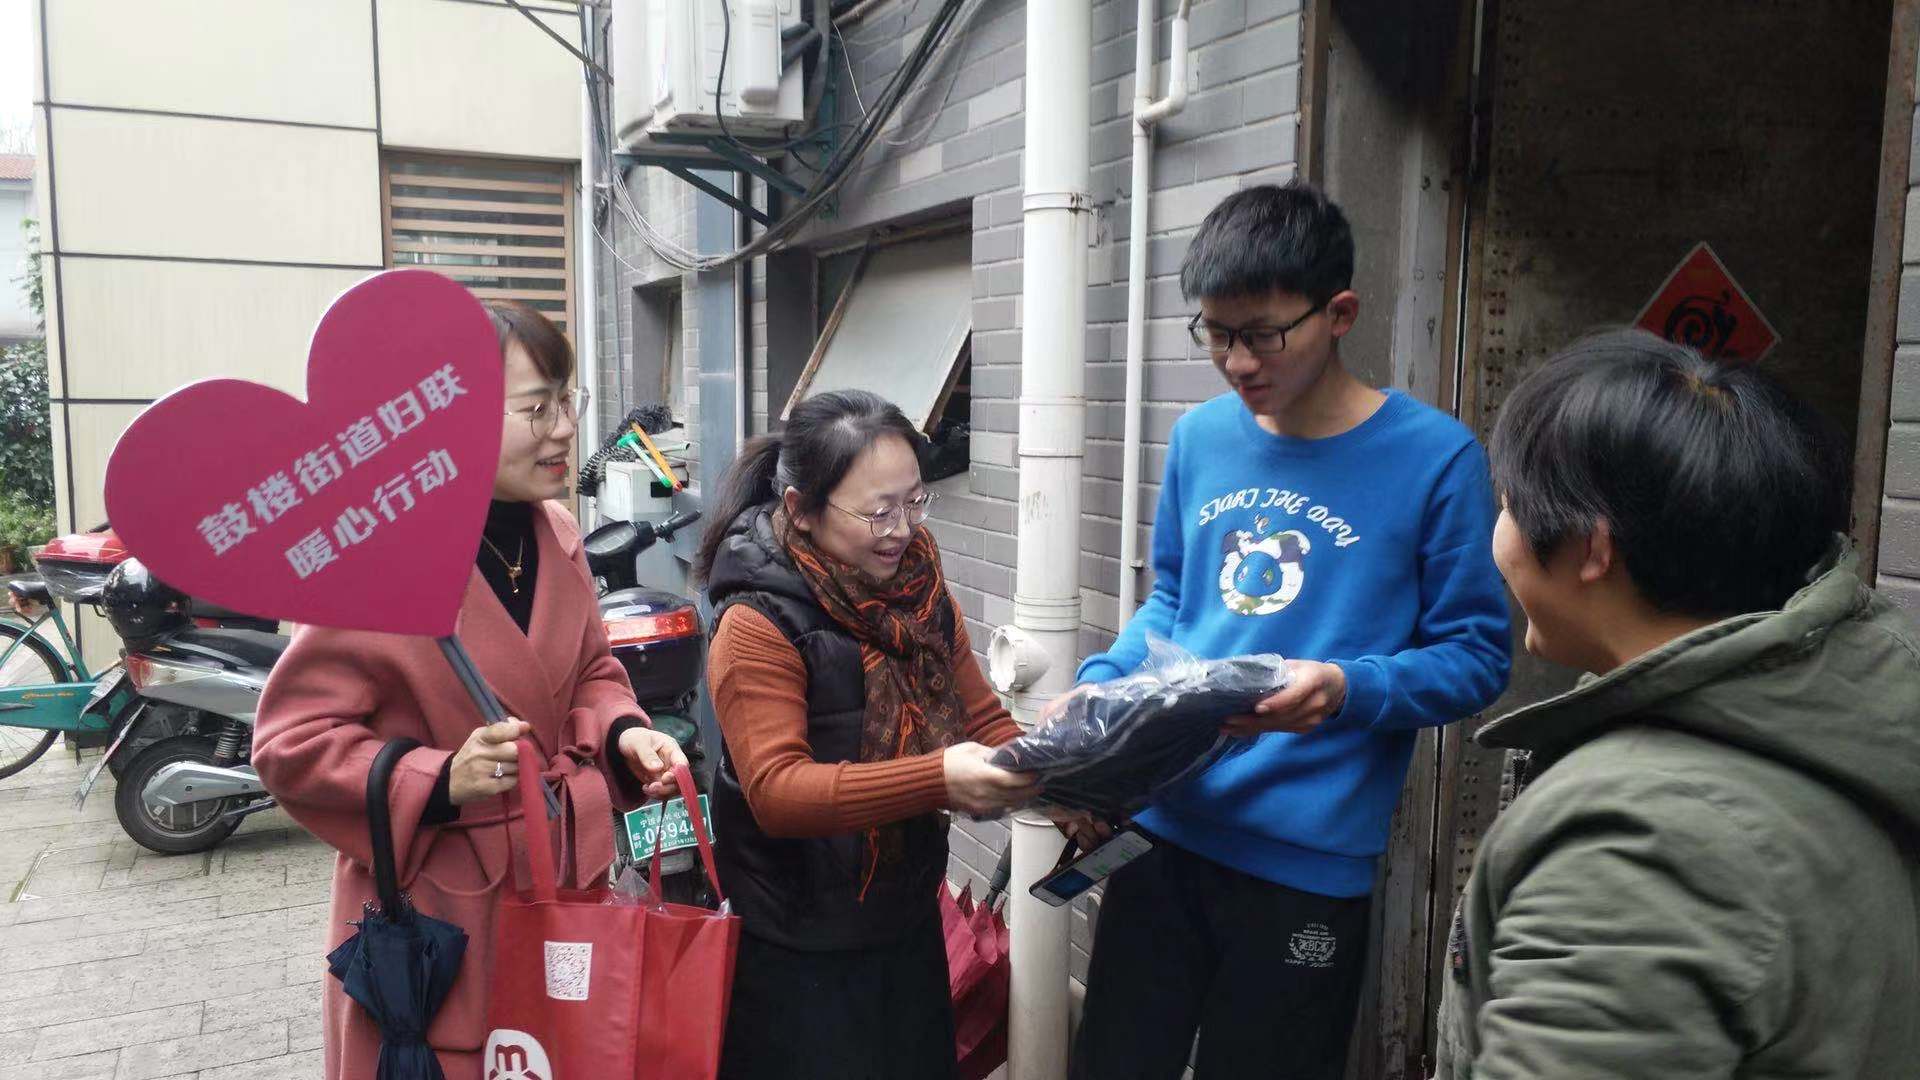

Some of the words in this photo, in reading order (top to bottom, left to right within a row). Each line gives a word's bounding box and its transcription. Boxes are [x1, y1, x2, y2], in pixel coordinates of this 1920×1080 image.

[197, 363, 468, 556] 鼓楼街道妇联
[285, 447, 458, 580] 暖心行动
[1199, 488, 1260, 526] START
[1260, 488, 1310, 515] THE
[1306, 505, 1360, 548] DAY
